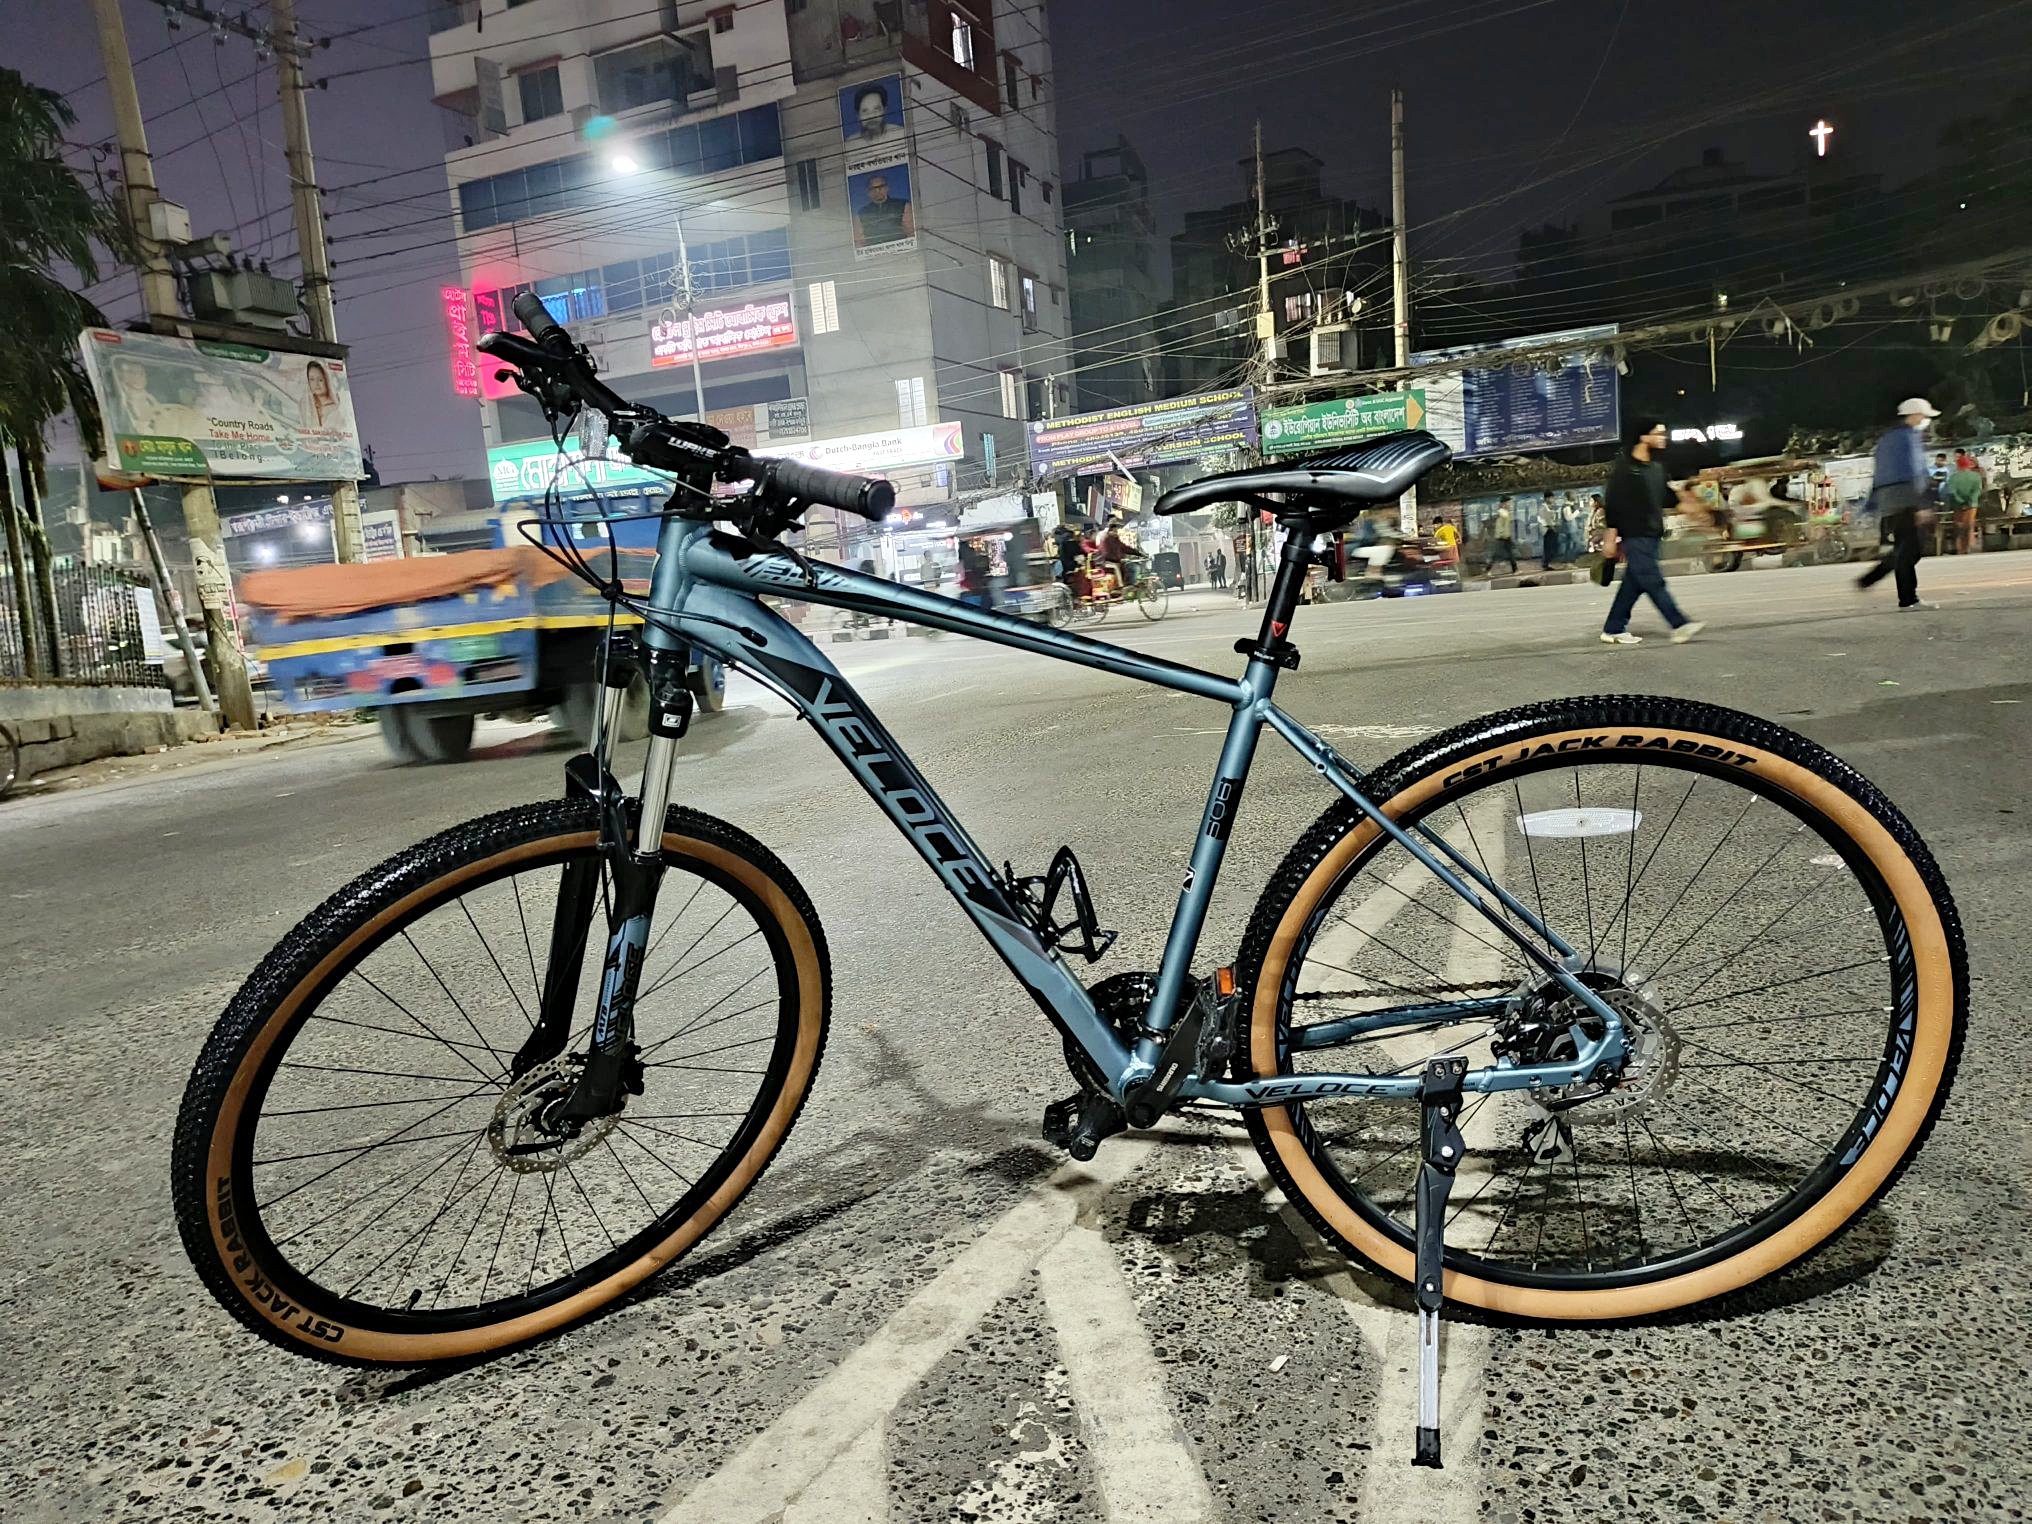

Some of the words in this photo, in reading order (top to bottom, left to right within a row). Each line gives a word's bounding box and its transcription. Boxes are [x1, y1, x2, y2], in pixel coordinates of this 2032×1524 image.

[248, 420, 274, 431] Roads
[1046, 413, 1105, 430] METHODIST
[1106, 406, 1152, 420] ENGLISH
[1154, 399, 1197, 412] MEDIUM
[1360, 411, 1371, 425] অব
[1374, 407, 1405, 424] বাংলাদেশ
[209, 428, 229, 439] Take
[231, 430, 244, 440] Me
[825, 441, 879, 455] Dutch-Bangla
[881, 437, 902, 447] Bank
[1443, 755, 1503, 790] CST
[1510, 735, 1609, 764] JACK
[1615, 734, 1757, 768] RABBIT
[811, 677, 995, 895] VELOCE
[1244, 1082, 1396, 1100] VELOCE
[217, 1176, 251, 1274] RABBIT
[245, 1270, 300, 1321] JACK
[296, 1315, 345, 1342] CST
